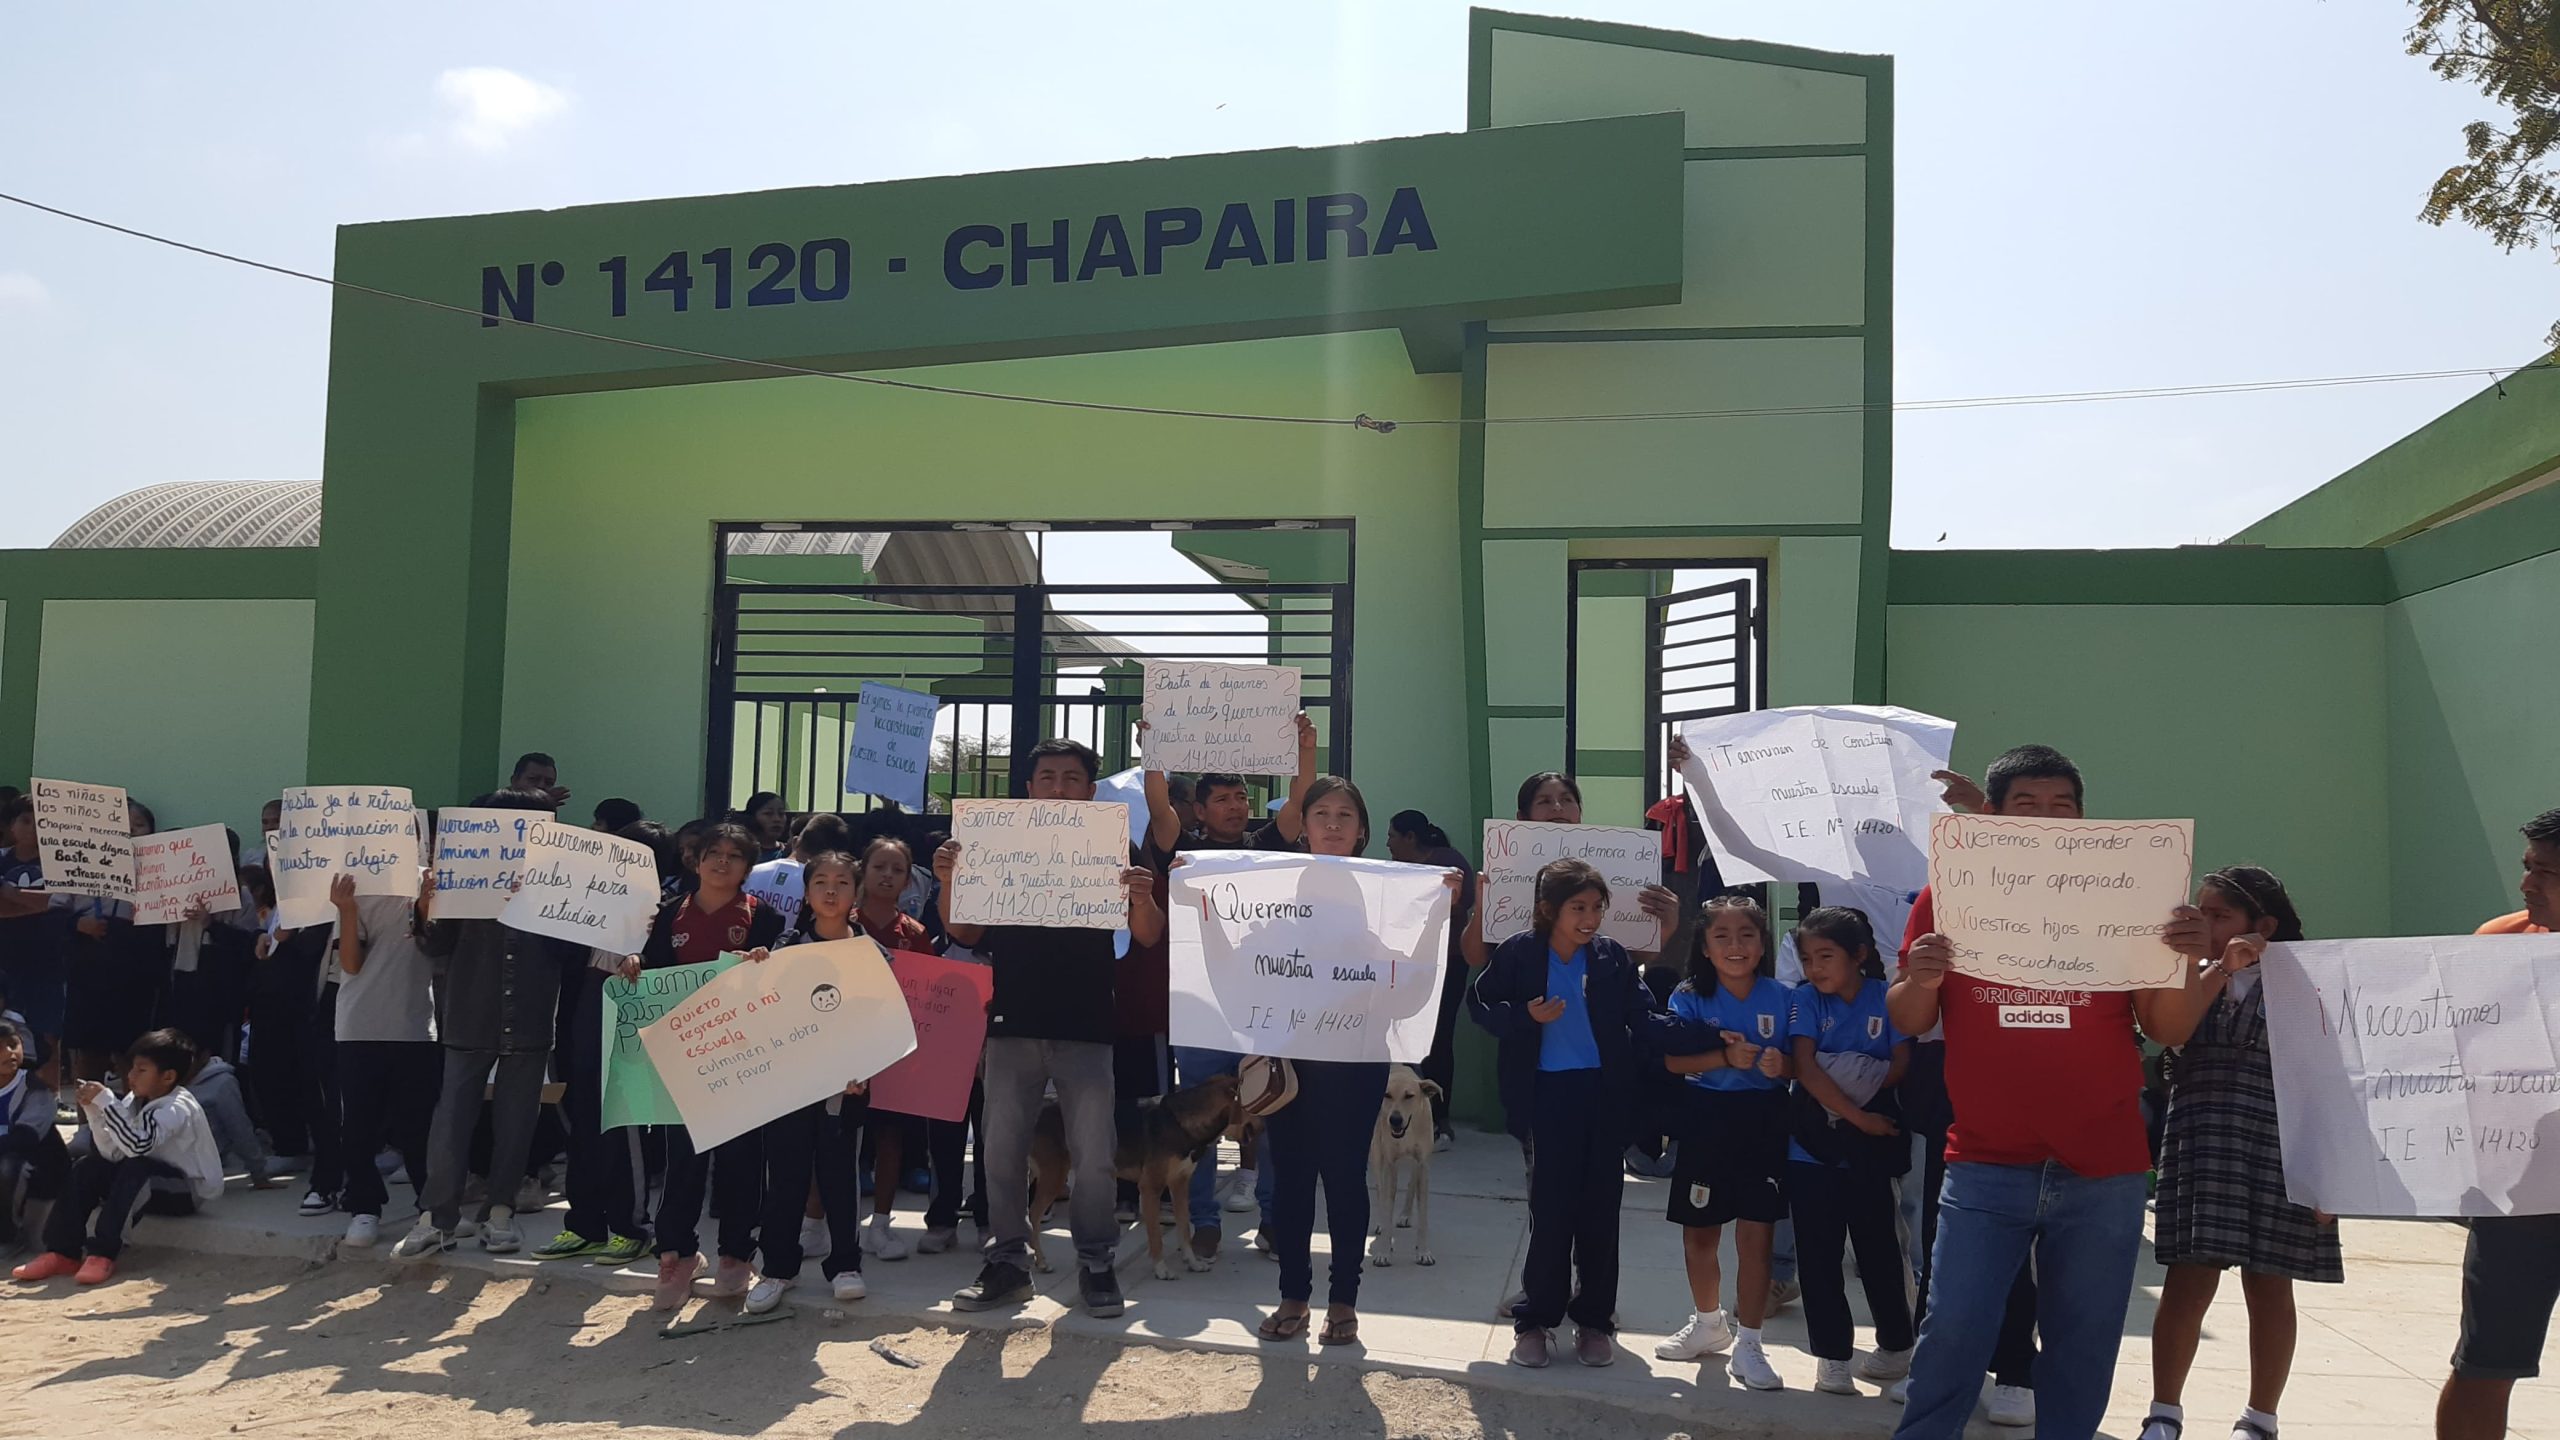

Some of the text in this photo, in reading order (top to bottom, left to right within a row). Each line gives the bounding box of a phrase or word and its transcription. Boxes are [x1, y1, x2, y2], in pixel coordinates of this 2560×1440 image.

[600, 237, 851, 318] 14120
[942, 186, 1439, 290] CHAPAIRA
[1154, 668, 1192, 691] Basta
[1200, 672, 1212, 689] de
[1163, 701, 1177, 717] de
[1152, 722, 1253, 754] nuestra escuela
[1182, 749, 1227, 770] 14120
[37, 782, 122, 808] Las niñas y
[1771, 778, 1880, 802] nuestra escuela
[63, 805, 101, 819] niños
[108, 809, 122, 823] de
[323, 794, 342, 817] ya
[348, 792, 360, 806] de
[1027, 805, 1086, 830] Alcalde
[305, 818, 399, 838] culminación
[438, 818, 500, 834] ueremos
[529, 822, 604, 855] Queremos
[1943, 815, 2173, 855] Queremos aprender en
[40, 836, 131, 857] una escuela digna
[55, 849, 113, 867] Basta de
[169, 837, 193, 856] que
[189, 852, 206, 867] la
[965, 841, 1040, 879] Exigimos
[1049, 834, 1066, 866] la
[1488, 829, 1659, 864] No a la demora del
[279, 848, 331, 872] nuestro
[586, 874, 629, 899] para
[957, 869, 1117, 896] ción de nuestra escuela
[1991, 866, 2036, 895] lugar
[2047, 871, 2141, 894] apropiado.
[538, 897, 608, 930] estudiar
[983, 891, 1048, 919] 14120
[1493, 896, 1653, 927] Exig escuela
[2043, 916, 2080, 941] hijos
[2098, 922, 2165, 937] merece
[1254, 948, 1314, 979] nuestra
[1332, 964, 1377, 983] escuela
[609, 969, 718, 1000] ueremo
[1972, 986, 2092, 1007] ORIGINALS
[670, 997, 721, 1032] Quiero
[678, 987, 782, 1043] regresar a mi
[1314, 1009, 1364, 1035] 14120
[2004, 1009, 2065, 1025] adidas
[686, 1028, 747, 1059] escuela
[770, 1037, 784, 1049] la
[789, 1023, 819, 1043] obra
[708, 1059, 773, 1094] por favor
[2375, 1055, 2560, 1100] nuestra escue
[2480, 1125, 2540, 1153] 14120
